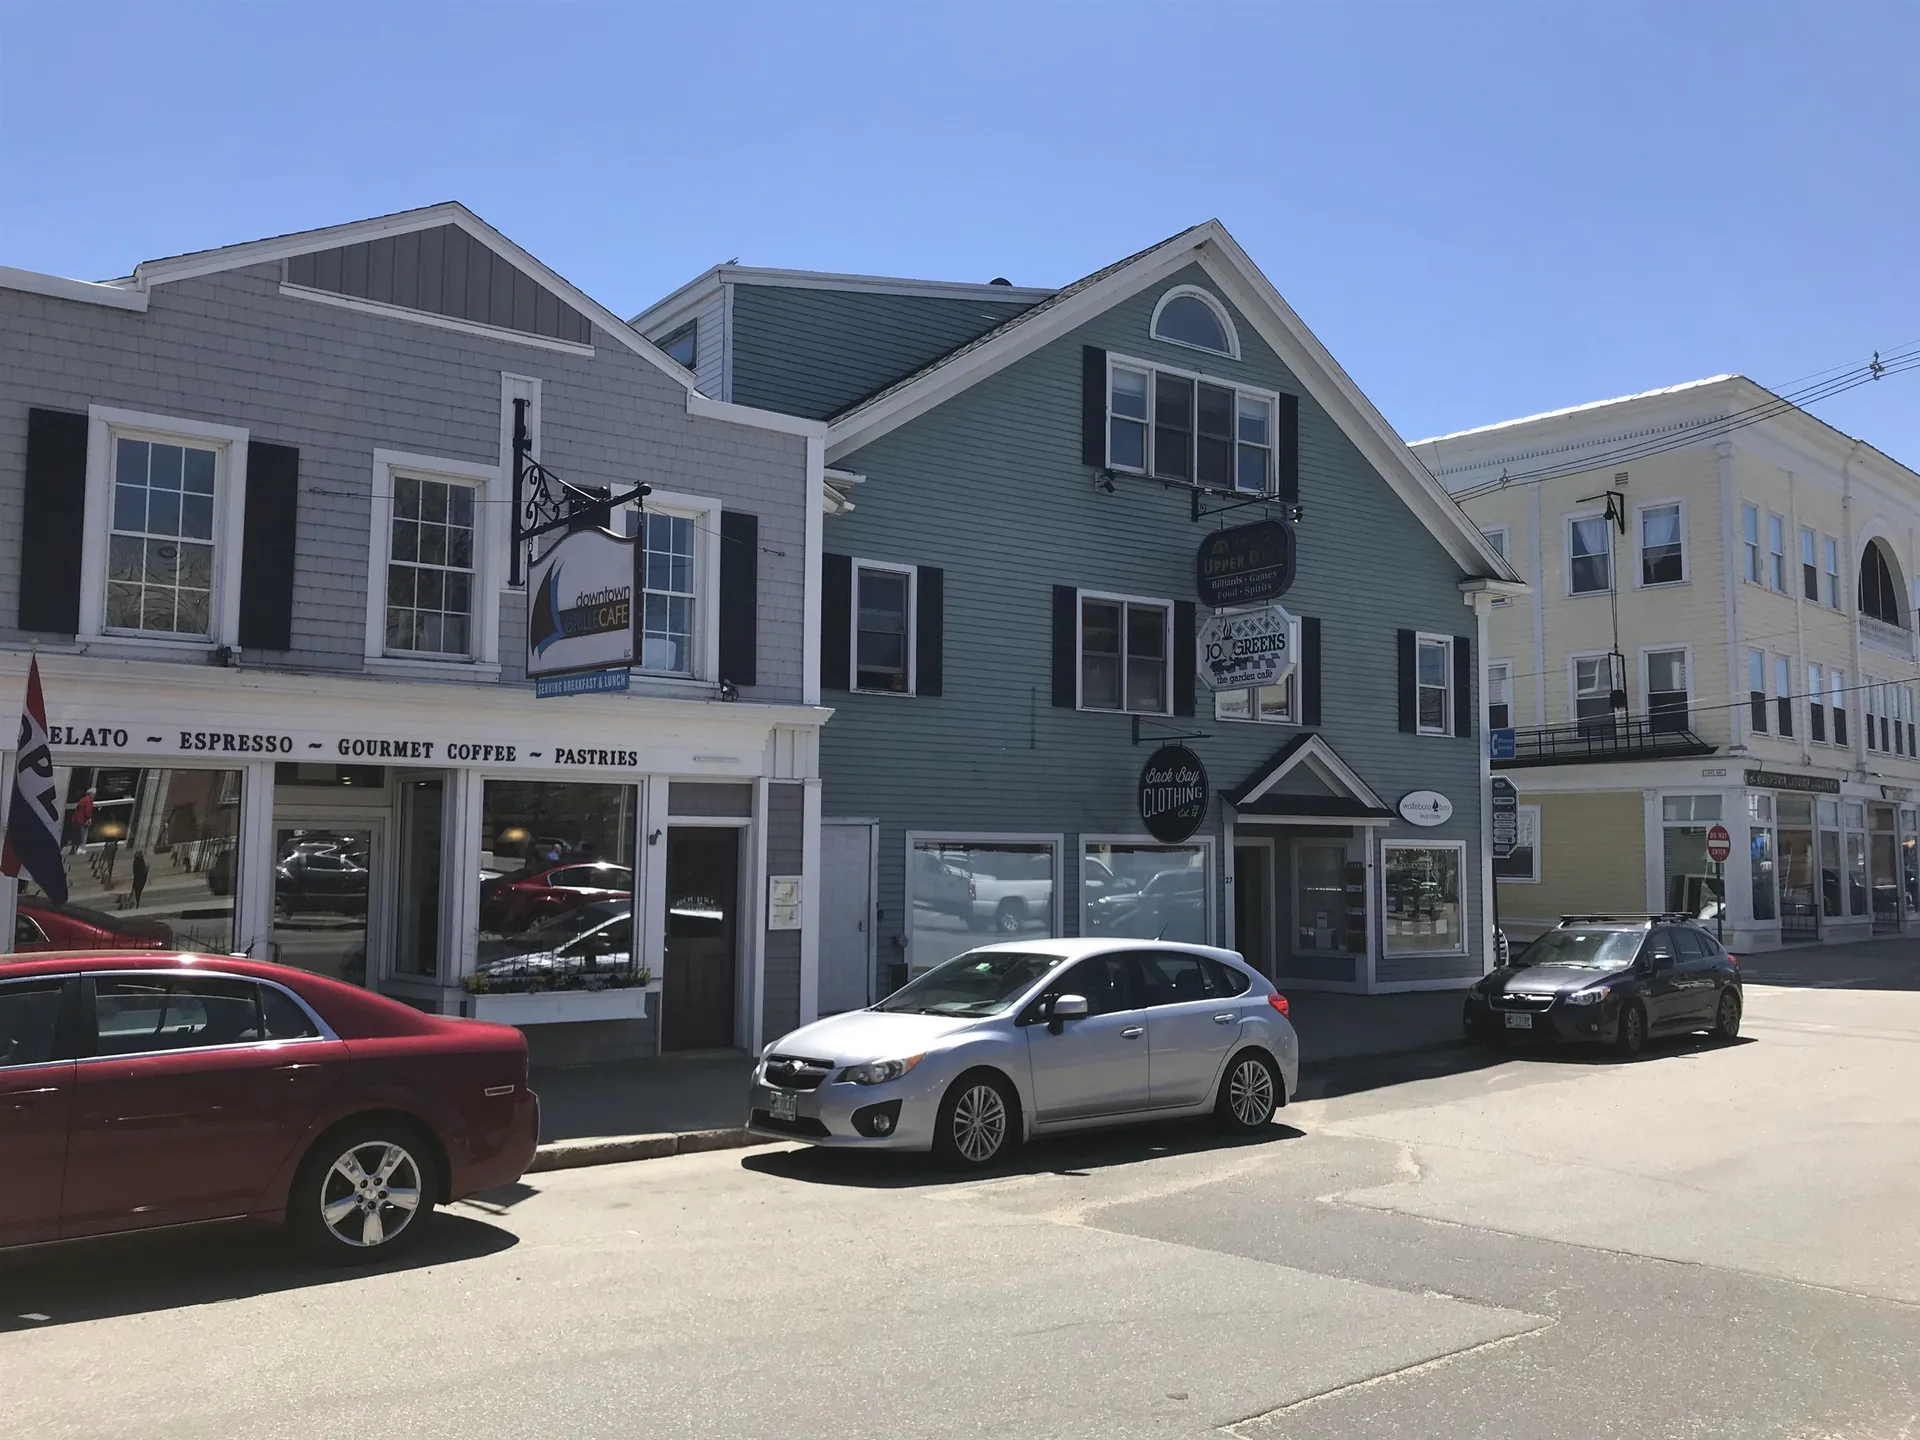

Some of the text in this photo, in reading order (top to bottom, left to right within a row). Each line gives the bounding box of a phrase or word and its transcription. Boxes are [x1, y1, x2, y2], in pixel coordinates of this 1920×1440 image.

[1204, 554, 1245, 575] UPPER
[1211, 570, 1278, 589] Billiards Games
[575, 585, 631, 608] downtown
[1217, 583, 1272, 600] Food Spirits
[1232, 633, 1286, 656] GREENS
[537, 674, 626, 695] SERVING BREAKFAST & LUNCH
[1216, 668, 1273, 685] the garden café
[48, 726, 129, 748] ELATO
[179, 731, 294, 753] ESPRESSO
[338, 738, 434, 759] GOURMET
[447, 743, 517, 762] COFFEE
[555, 748, 639, 767] PASTRIES
[1145, 766, 1200, 787] Back Bay
[1143, 786, 1203, 818] CLOTHING
[1438, 802, 1450, 812] bay
[1718, 832, 1727, 840] NOT
[1711, 848, 1726, 856] ENTER
